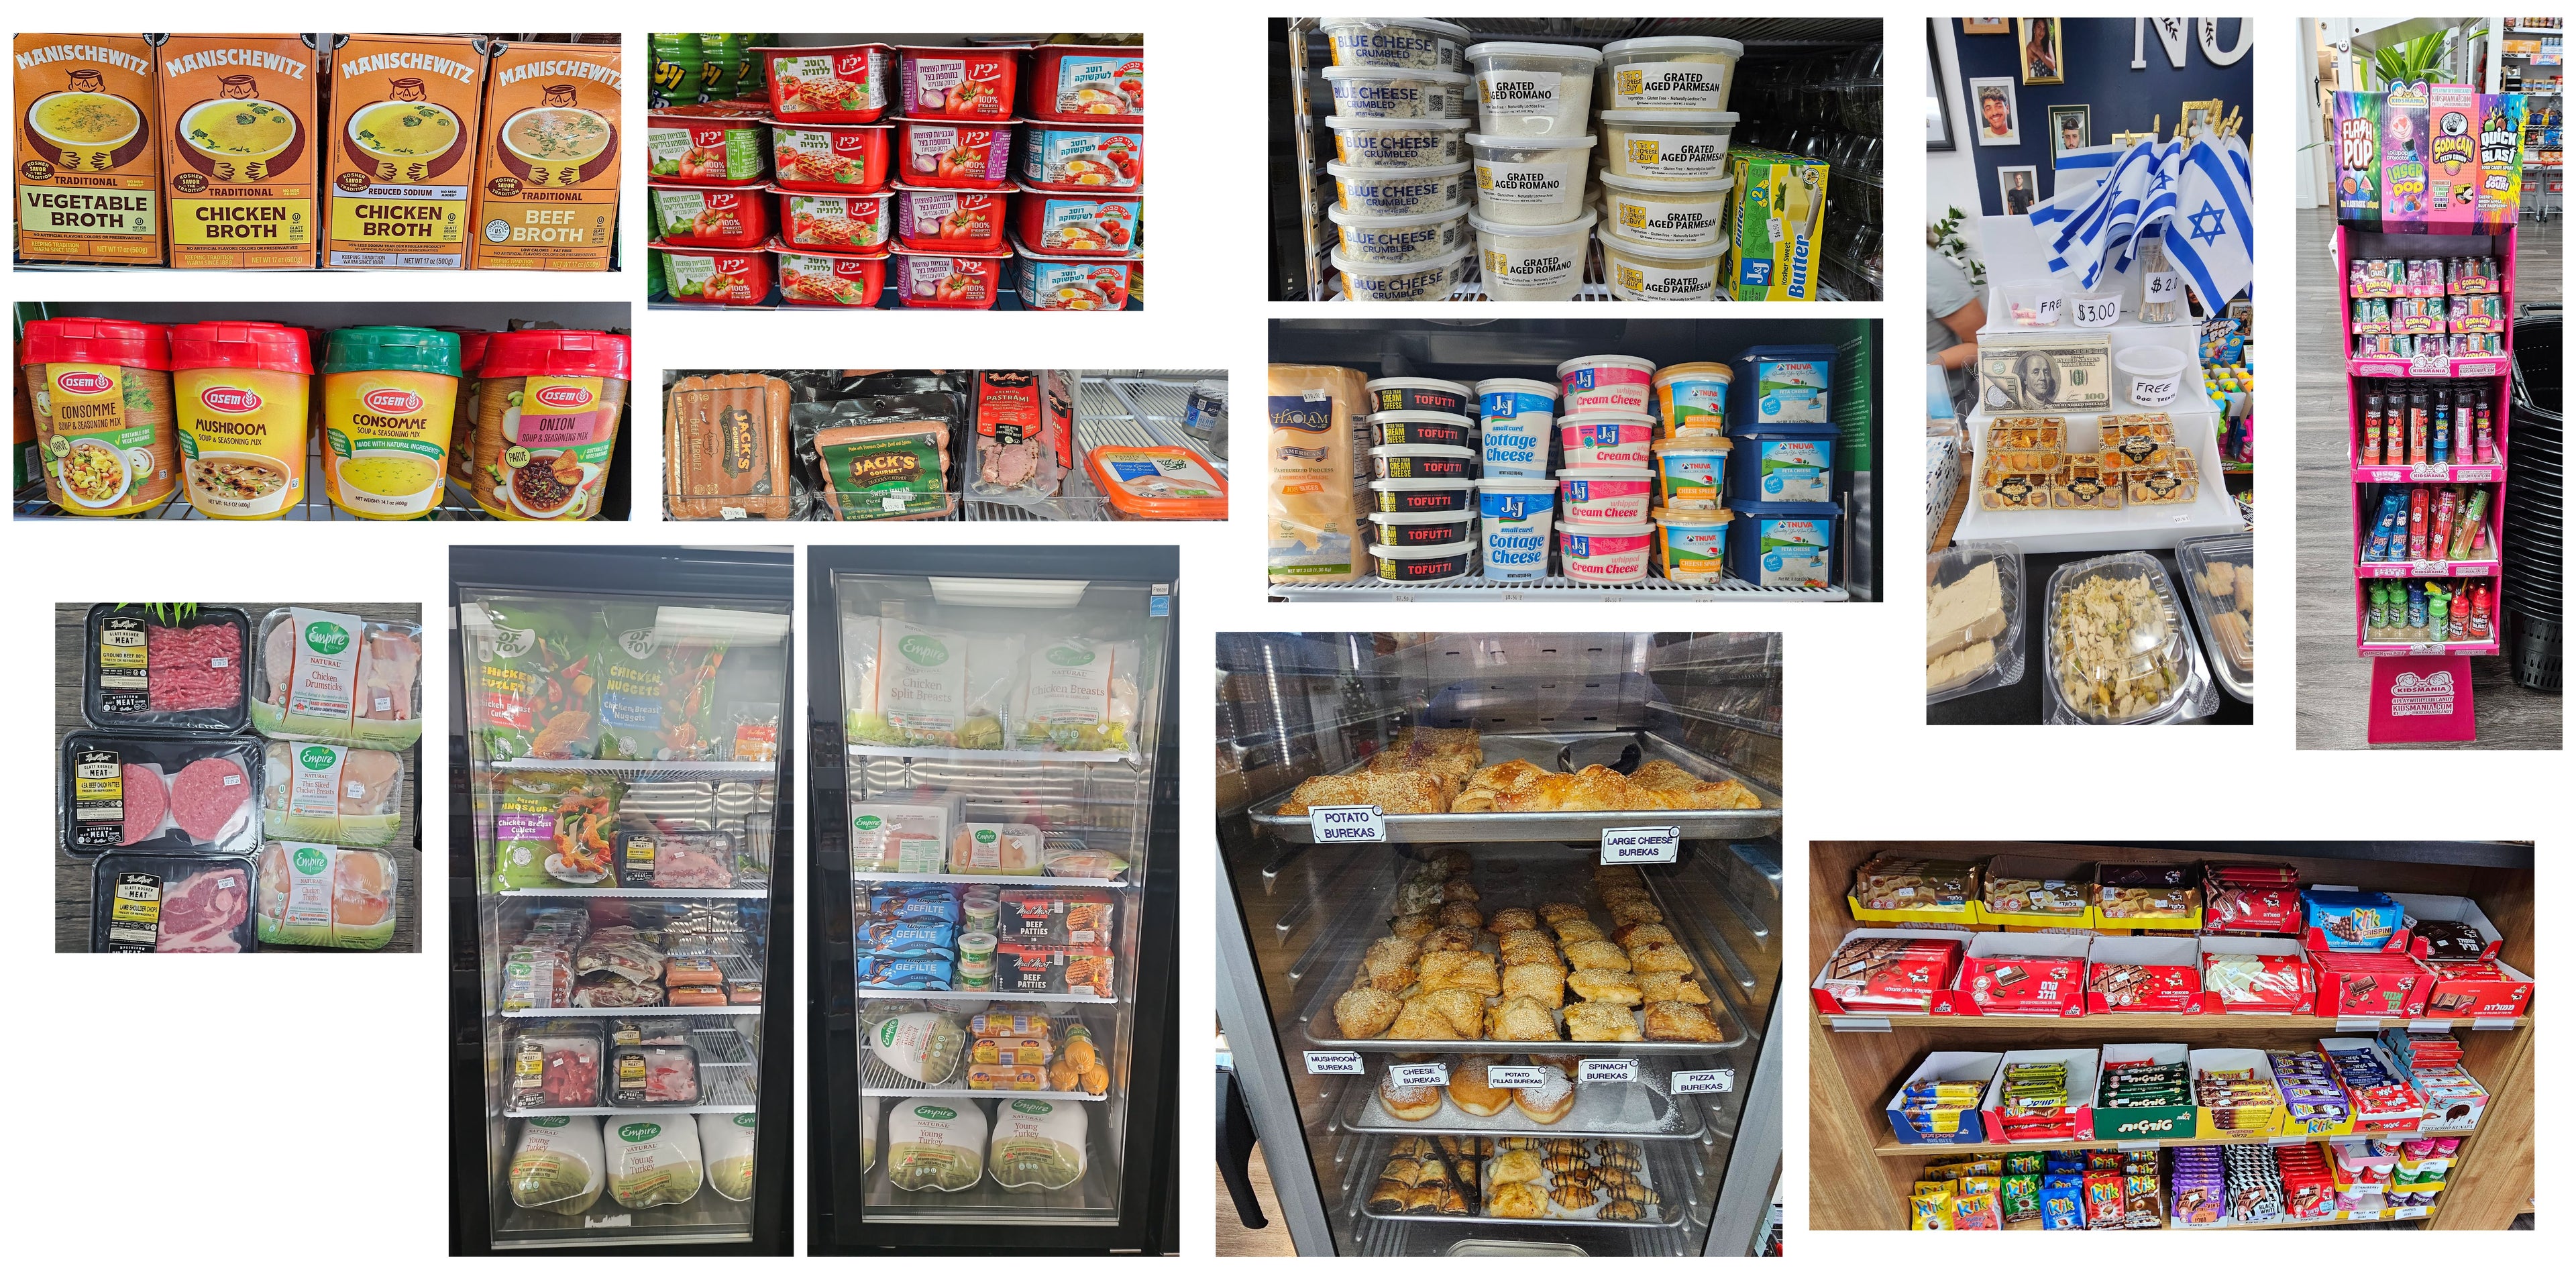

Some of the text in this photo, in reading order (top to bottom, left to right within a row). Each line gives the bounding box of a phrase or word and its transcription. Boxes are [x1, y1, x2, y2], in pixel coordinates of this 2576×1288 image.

[1338, 36, 1432, 52] BLUE CHEESE
[1356, 50, 1410, 58] CRUMBLED
[15, 44, 149, 77] MANISCHEWITZ
[166, 49, 307, 80] MANISCHEWITZ
[342, 52, 475, 85] MANISCHEWITZ
[802, 66, 830, 76] ללזניה
[920, 64, 939, 73] קצוצות
[1075, 71, 1111, 83] לשקשוקה
[1664, 73, 1703, 82] GRATED
[1645, 83, 1719, 92] AGED PARMESAN
[2344, 139, 2373, 168] POP
[2435, 138, 2473, 158] SODA CAN
[54, 176, 117, 186] TRADITIONAL
[1507, 173, 1544, 182] GRATED
[1495, 180, 1560, 189] AGED ROMANO
[28, 193, 147, 211] VEGETABLE
[522, 193, 582, 201] TRADITIONAL
[196, 207, 286, 221] CHICKEN
[355, 205, 442, 220] CHICKEN
[526, 210, 575, 225] BEEF
[52, 212, 123, 227] BROTH
[207, 225, 277, 237] BROTH
[364, 223, 432, 237] BROTH
[513, 228, 583, 242] BROTH
[1746, 261, 1769, 284] J&J
[1789, 234, 1809, 299] Butter
[2077, 302, 2116, 322] $3.00
[66, 378, 93, 387] OSEM
[2137, 382, 2171, 393] FREE
[1616, 387, 1643, 397] whipped
[211, 394, 241, 405] OSEM
[1383, 394, 1401, 403] CREAM
[1415, 395, 1455, 408] TOFUTTI
[1576, 395, 1641, 407] Cream Cheese
[62, 402, 116, 419] CONSOMME
[1384, 401, 1402, 410] CHEESE
[1493, 395, 1513, 415] J&J
[59, 422, 71, 430] SOUP
[78, 419, 107, 429] SEASONING
[110, 418, 121, 426] MIX
[196, 419, 266, 435] MUSHROOM
[353, 414, 427, 429] CONSOMME
[539, 417, 575, 431] ONION
[122, 431, 141, 439] SUITABLE
[122, 435, 150, 444] VEGETARIANS
[1485, 433, 1537, 448] Cottage
[690, 419, 701, 472] BEEF MERGUEZ
[508, 451, 527, 462] PARVE
[1487, 448, 1534, 463] Cheese
[854, 456, 916, 476] JACK'S
[870, 468, 902, 476] GOURMET
[309, 627, 345, 652] Empire
[312, 672, 337, 682] Chicken
[610, 665, 661, 684] CHICKEN
[305, 680, 342, 691] Drumsticks
[608, 680, 660, 696] NUGGETS
[902, 678, 943, 691] Chicken
[891, 688, 952, 702] Split Breasts
[1325, 812, 1368, 823] POTATO
[1325, 827, 1375, 839] BUREKAS
[1608, 835, 1673, 847] LARGE CHEESE
[1618, 847, 1659, 857] BUREKAS
[2351, 910, 2380, 930] klik
[896, 930, 936, 938] GEFILTE
[2363, 928, 2392, 936] CRISPINI
[2041, 981, 2058, 989] קרם
[2037, 990, 2056, 1000] חלב
[918, 1137, 943, 1146] Turkey
[920, 1130, 943, 1141] Young
